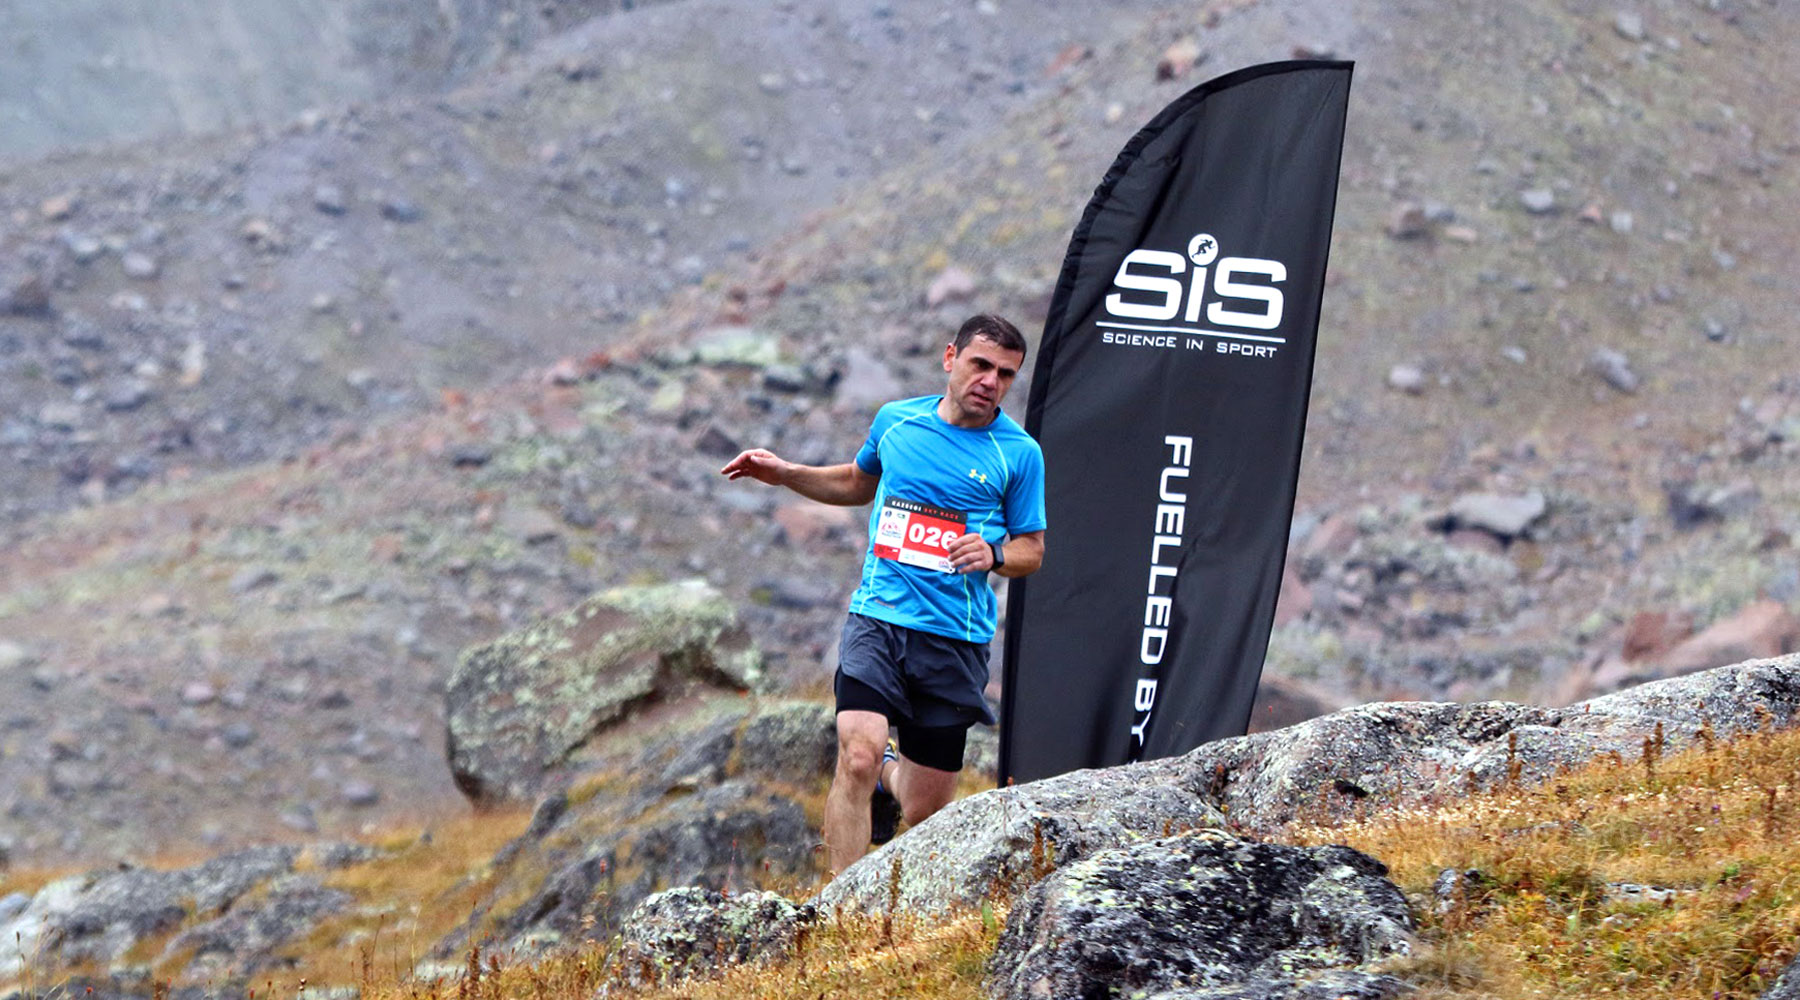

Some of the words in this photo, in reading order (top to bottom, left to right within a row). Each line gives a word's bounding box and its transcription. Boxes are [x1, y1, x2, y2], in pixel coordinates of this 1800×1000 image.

[1102, 332, 1177, 348] SCIENCE
[1186, 338, 1204, 351] IN
[1216, 341, 1278, 358] SPORT
[908, 522, 958, 550] 026
[1140, 435, 1194, 665] FUELLED
[1131, 678, 1161, 747] BY
